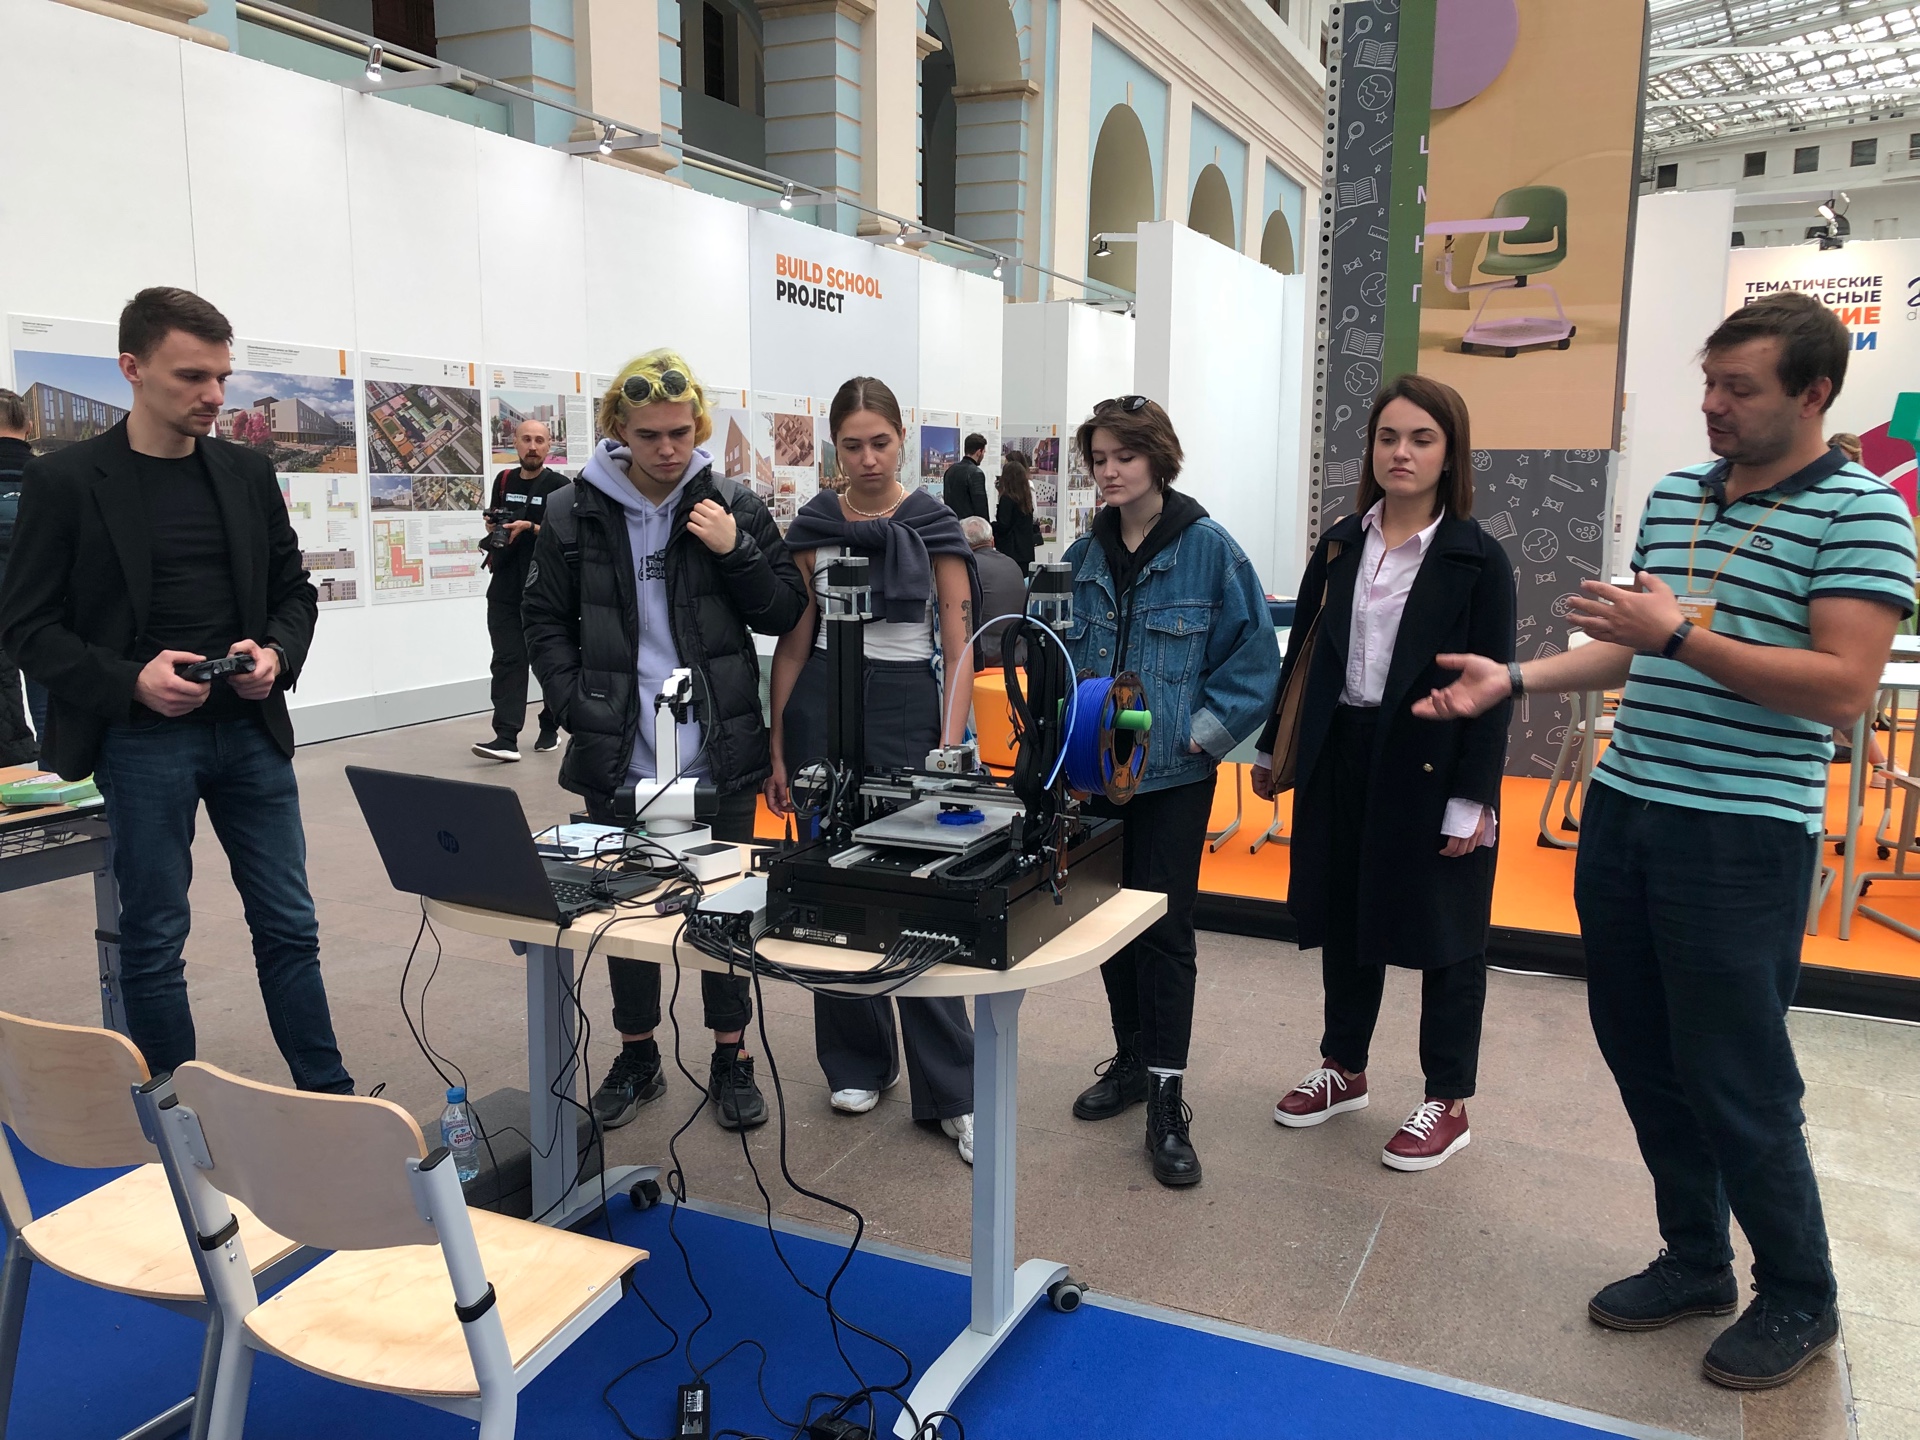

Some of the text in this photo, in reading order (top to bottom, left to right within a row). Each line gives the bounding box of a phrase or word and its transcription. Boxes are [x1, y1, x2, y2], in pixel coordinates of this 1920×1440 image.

[776, 253, 883, 300] BUILD SCHOOL
[1745, 275, 1883, 293] ТЕМАТИЧЕСКИЕ
[776, 279, 844, 314] PROJECT
